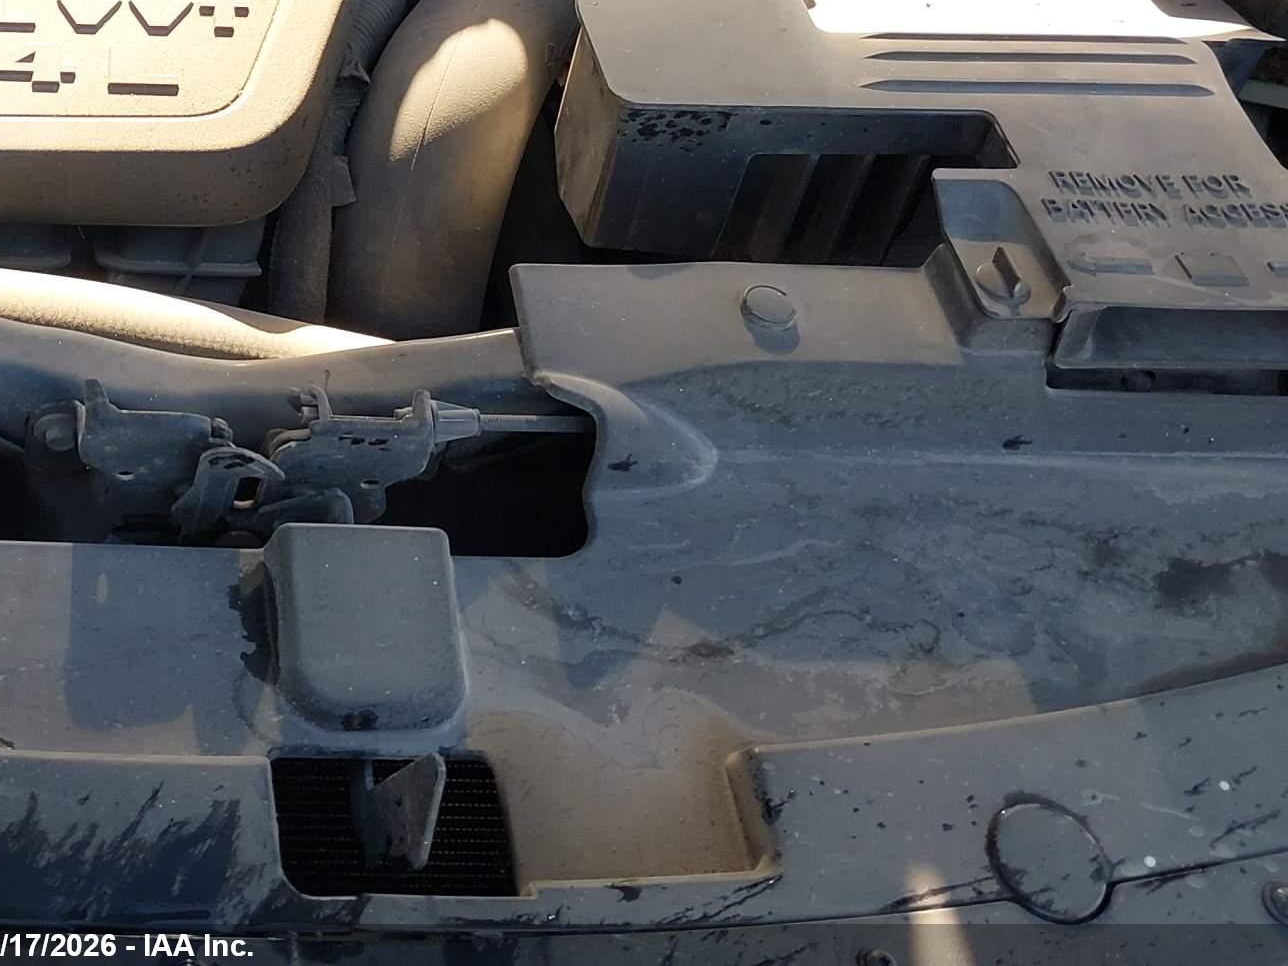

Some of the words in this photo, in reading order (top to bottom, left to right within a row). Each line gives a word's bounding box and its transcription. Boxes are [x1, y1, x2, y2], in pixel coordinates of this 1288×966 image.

[1048, 170, 1183, 200] REMOVE
[1182, 174, 1253, 200] FOR
[1040, 198, 1170, 228] BATTERY
